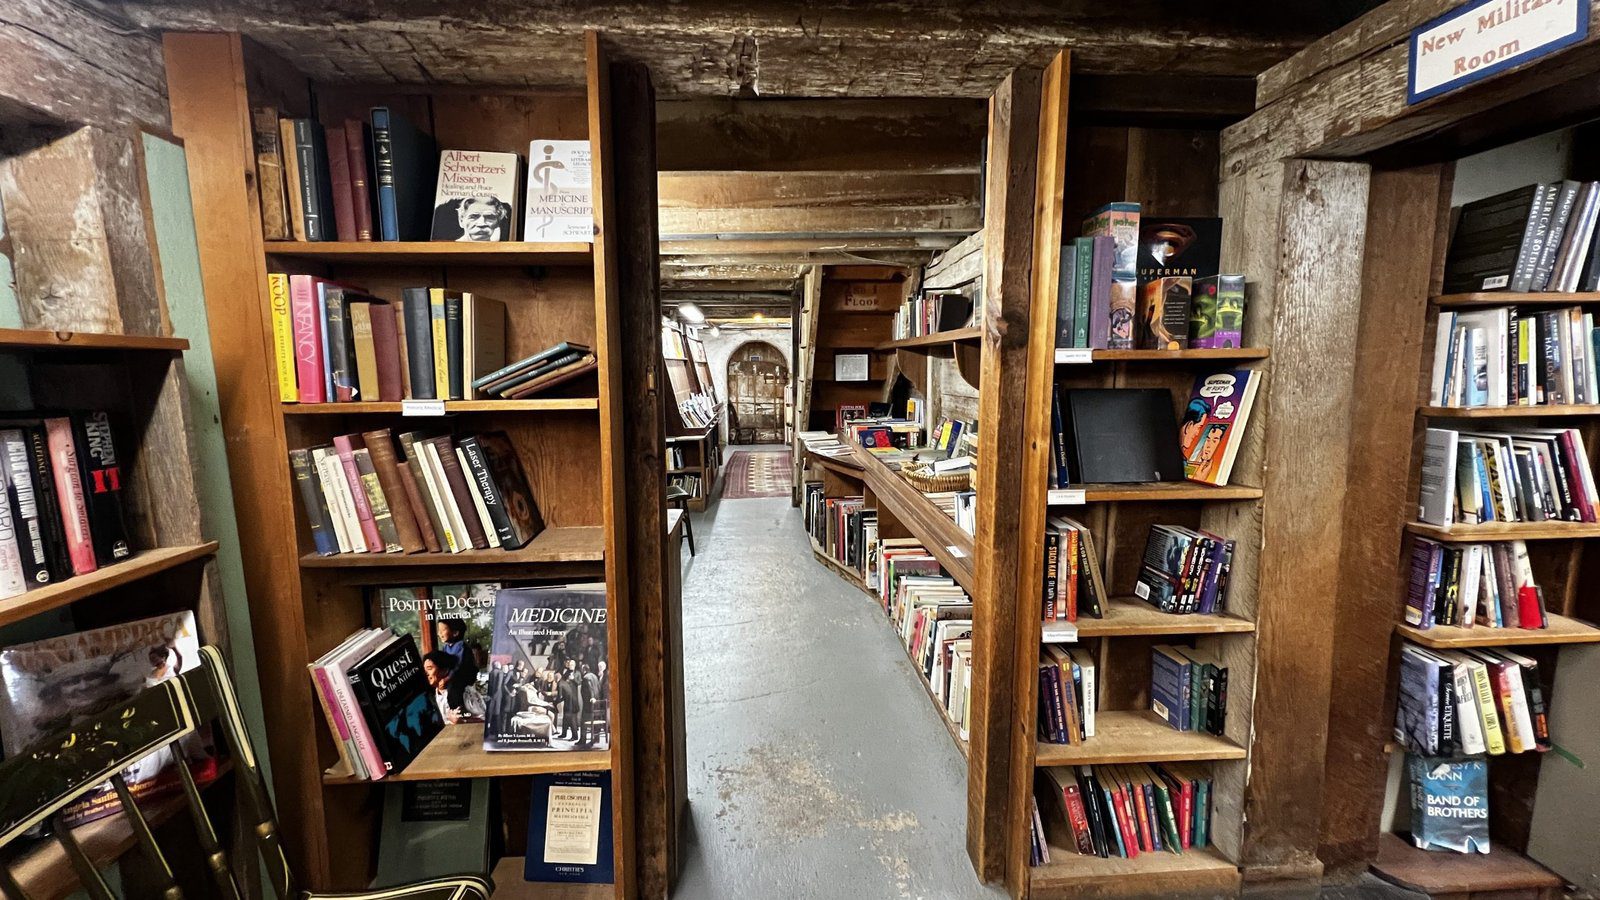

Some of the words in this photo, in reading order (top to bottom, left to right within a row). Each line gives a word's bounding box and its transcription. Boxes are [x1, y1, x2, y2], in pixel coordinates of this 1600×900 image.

[1421, 27, 1466, 56] New
[1453, 39, 1520, 75] Room
[442, 161, 506, 174] Schweitzer's
[444, 152, 480, 162] Albert
[442, 172, 486, 184] Mission
[441, 189, 471, 197] Norman
[472, 190, 498, 198] Cousins
[539, 194, 588, 203] MEDICINE
[1530, 185, 1544, 219] GENERAL
[1536, 186, 1558, 238] AMERICAN
[1558, 189, 1575, 225] SHADOW
[1524, 221, 1536, 247] TOMMY
[1524, 238, 1543, 279] SOLDIER
[272, 276, 287, 315] KOOP
[844, 294, 879, 306] FLOOR
[296, 301, 316, 366] INFANCY
[1545, 337, 1553, 358] HALF
[7, 441, 27, 462] ACTS
[86, 422, 98, 458] KING
[94, 411, 116, 466] STEPHEN
[66, 449, 82, 492] Surgeon
[75, 493, 83, 503] to
[93, 467, 121, 493] IT
[466, 443, 481, 469] Laser
[477, 469, 496, 505] Therapy
[13, 472, 37, 519] CONTRITION
[1048, 545, 1057, 562] STACIA
[1047, 562, 1057, 578] KANE
[389, 597, 443, 612] POSITIVE
[425, 611, 434, 621] in
[436, 610, 472, 620] America
[509, 607, 607, 623] MEDICINE
[1046, 598, 1055, 618] INSIDE
[371, 648, 414, 689] Quest
[376, 689, 387, 702] for
[386, 681, 399, 695] the
[398, 667, 420, 686] Killers
[336, 688, 354, 722] UNLEARNED
[349, 722, 366, 751] LANGUAGE
[1443, 705, 1453, 741] ETIQUETTE
[62, 800, 90, 814] Angela
[92, 791, 118, 807] Saulin
[1426, 794, 1461, 806] BAND
[1463, 796, 1480, 806] OF
[1427, 807, 1487, 818] BROTHERS
